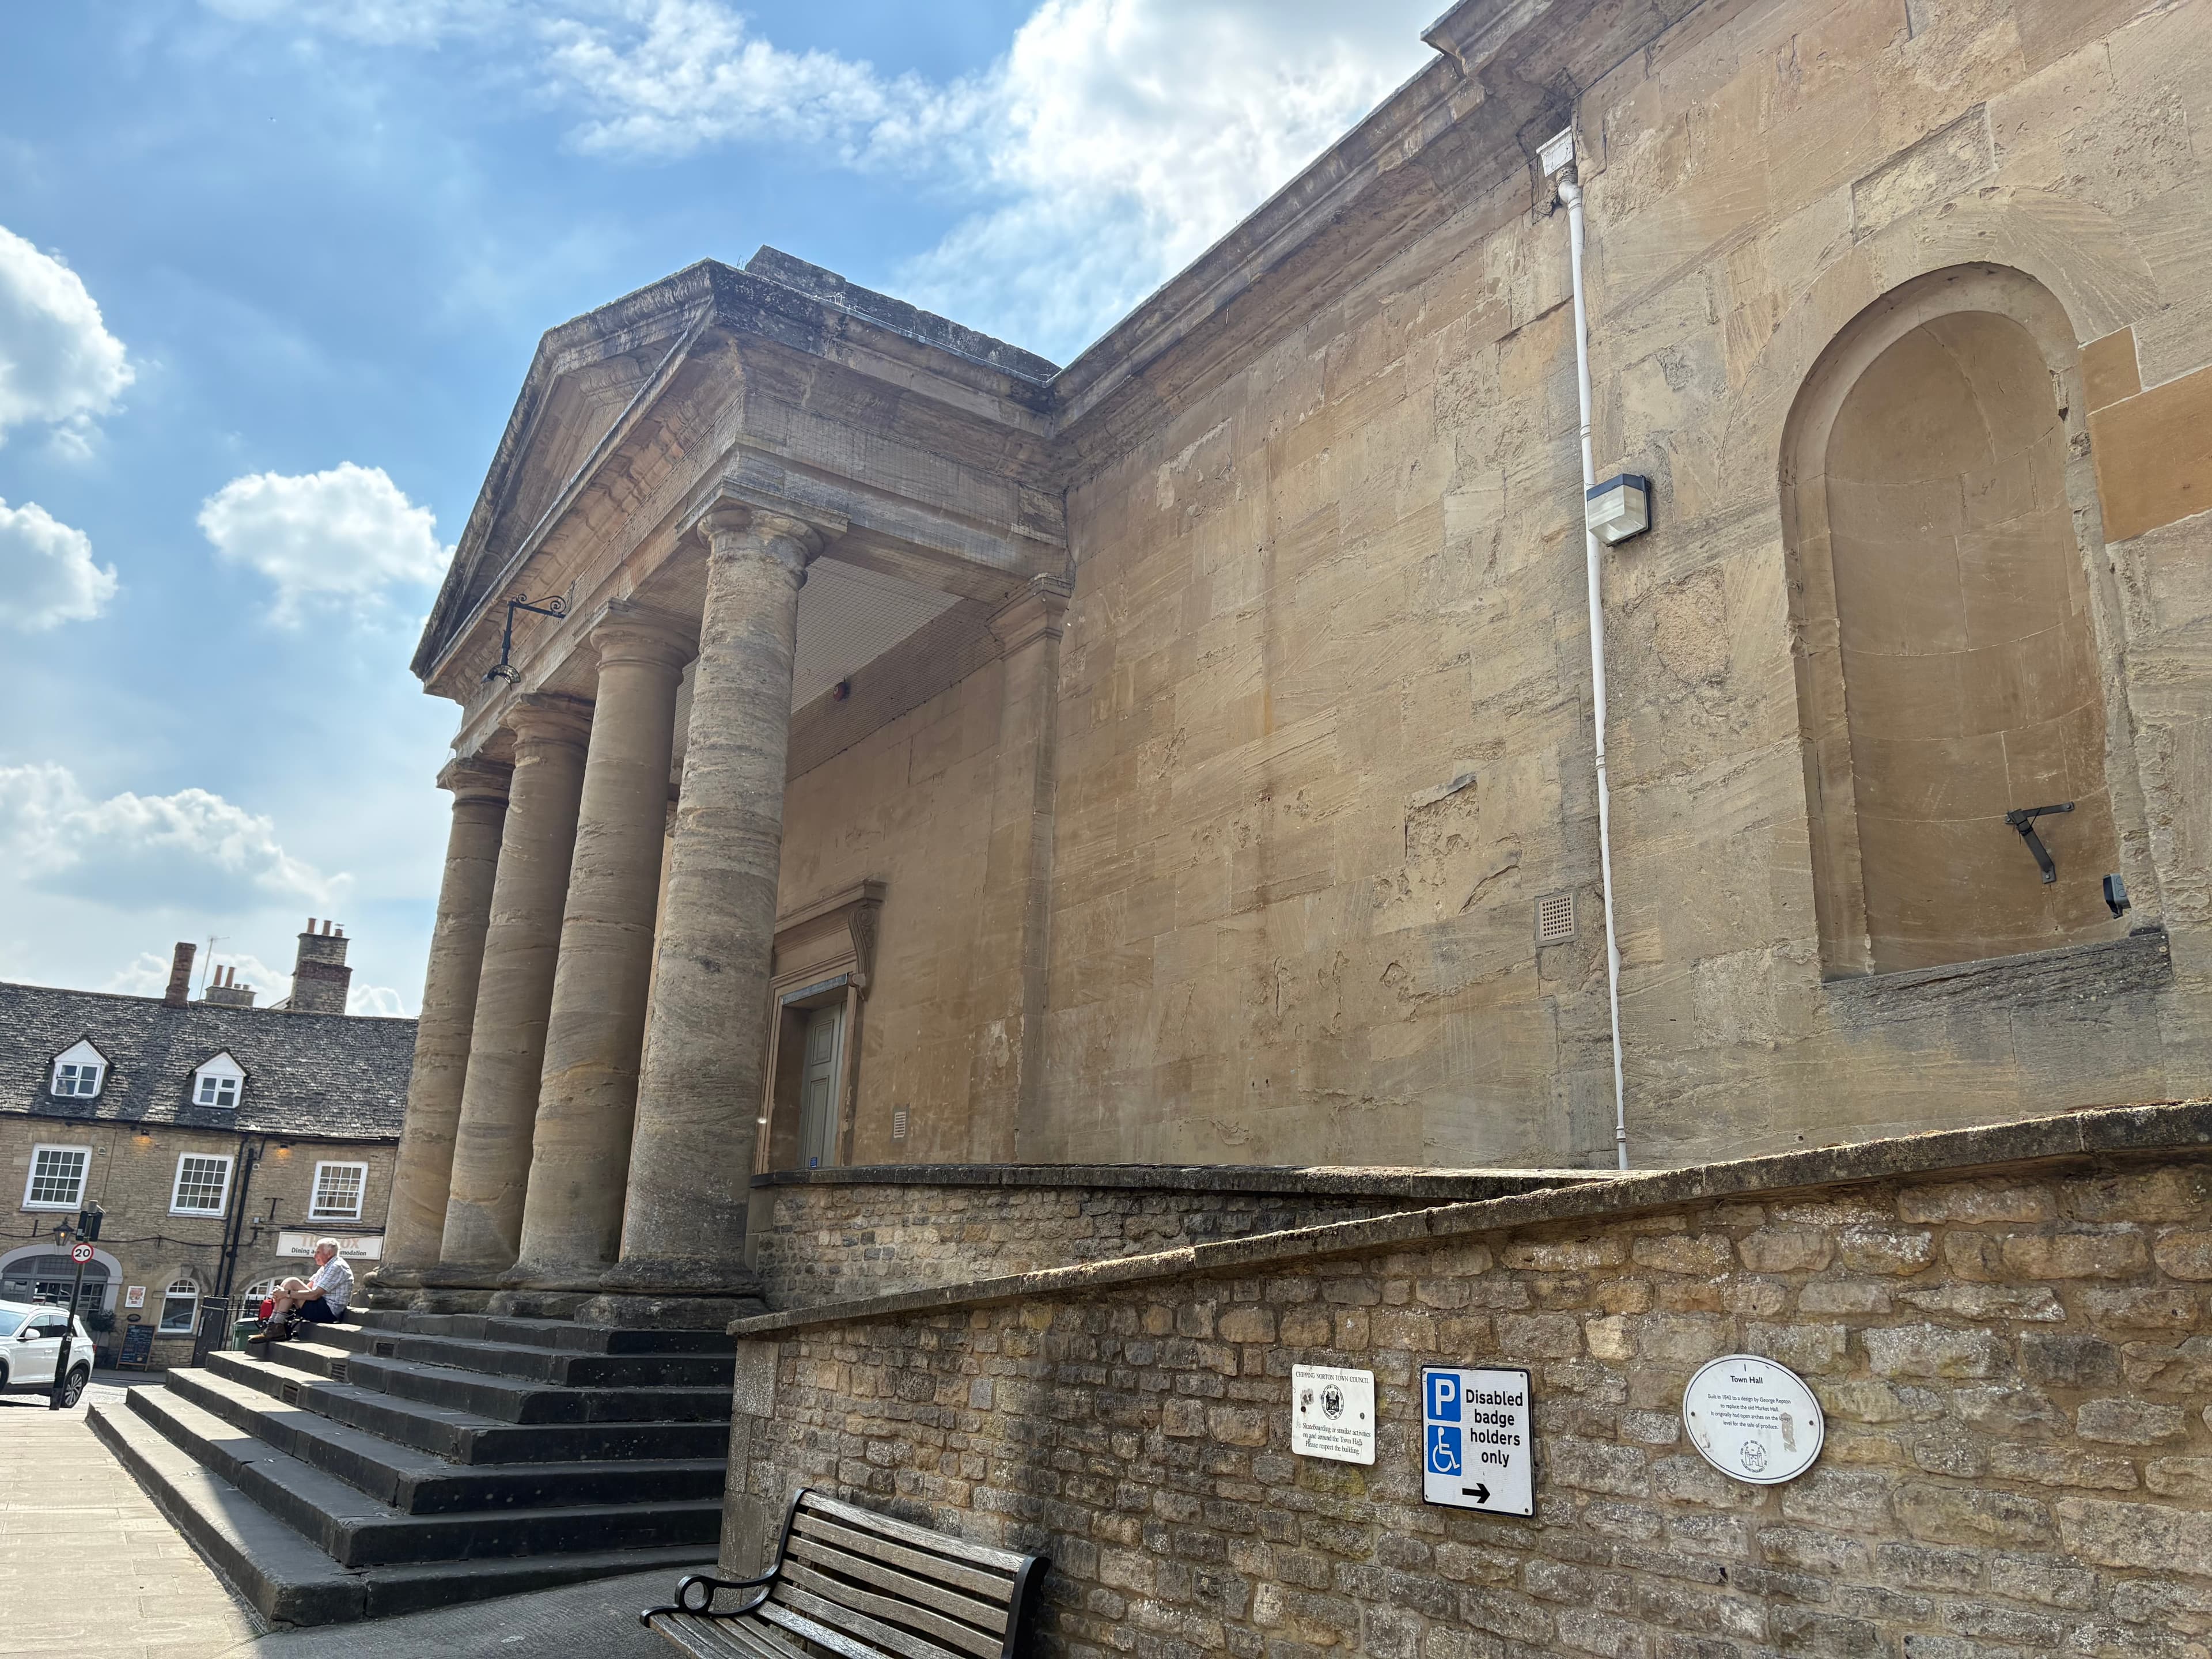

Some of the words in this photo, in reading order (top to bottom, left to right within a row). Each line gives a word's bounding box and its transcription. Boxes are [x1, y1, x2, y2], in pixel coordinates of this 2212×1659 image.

[340, 1238, 360, 1249] OX
[75, 1248, 90, 1257] 20
[1435, 1378, 1456, 1415] P
[1466, 1389, 1523, 1406] Disabled
[1475, 1408, 1514, 1428] badge
[1302, 1422, 1331, 1434] Skateboarding
[1305, 1439, 1318, 1448] Please
[1339, 1436, 1351, 1444] Town
[1471, 1427, 1520, 1446] holders
[1482, 1449, 1510, 1468] only
